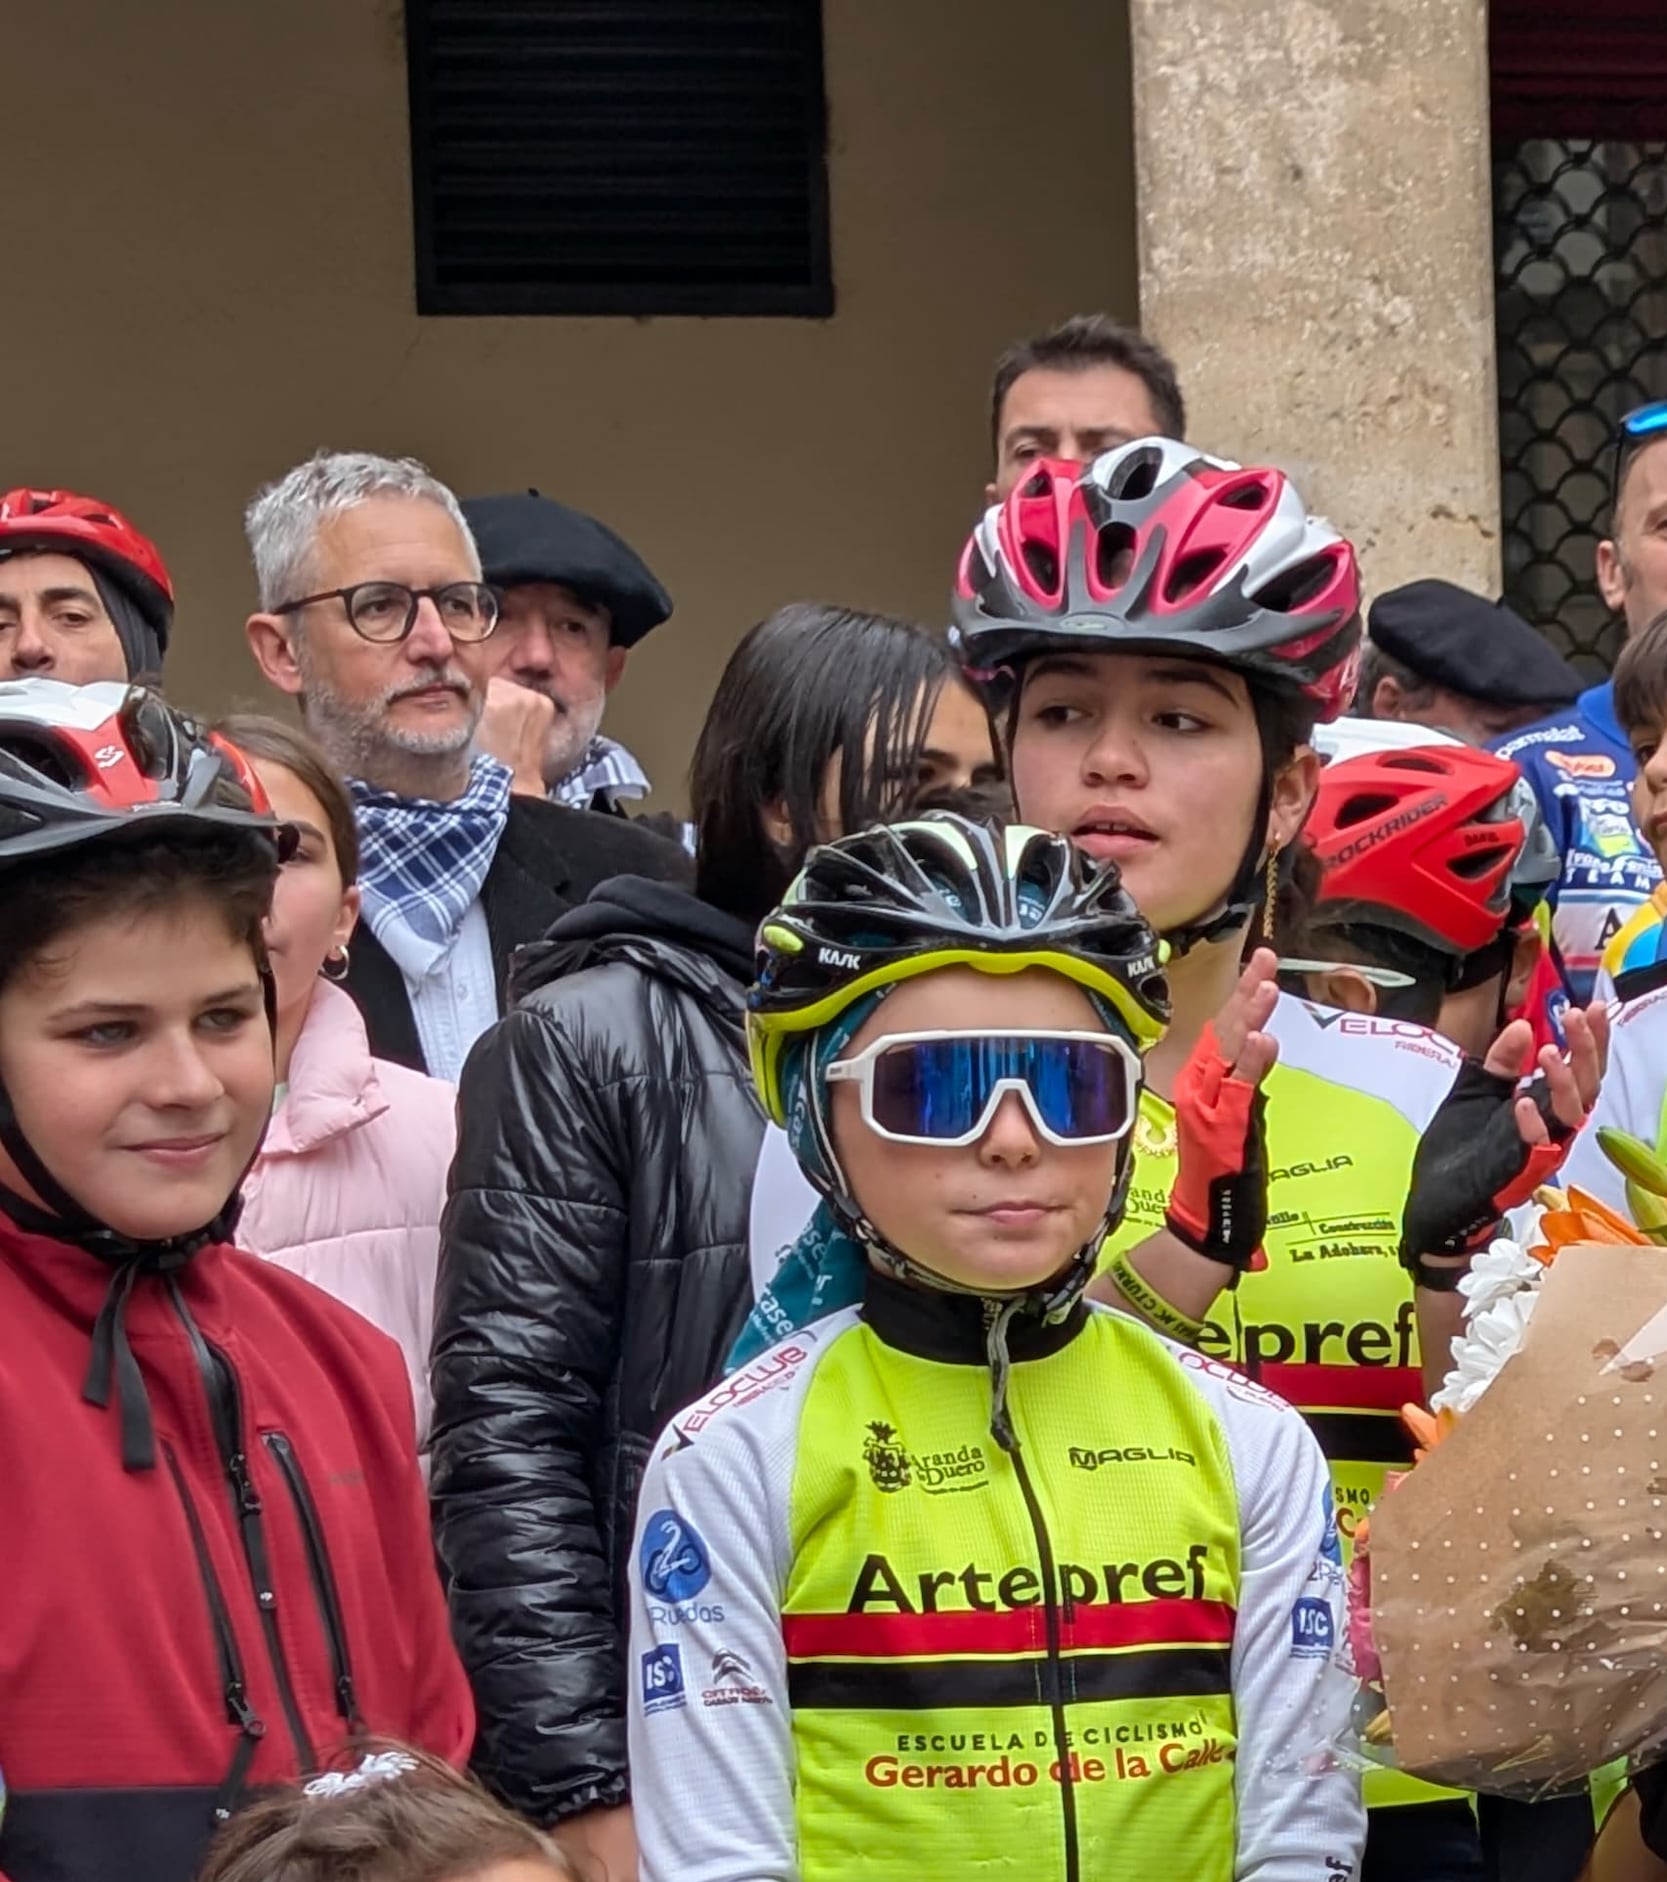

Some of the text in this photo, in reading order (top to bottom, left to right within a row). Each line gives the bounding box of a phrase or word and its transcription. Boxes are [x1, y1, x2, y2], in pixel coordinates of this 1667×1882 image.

[1269, 1154, 1354, 1183] AGLIA
[1068, 1446, 1196, 1471] MAGLIA
[848, 1545, 1208, 1625] Artepref
[897, 1733, 1024, 1751] ESCUELA
[1083, 1719, 1203, 1745] CICLISMO
[864, 1753, 1038, 1789] Gerardo
[1048, 1751, 1105, 1786] de
[1115, 1747, 1151, 1780] la
